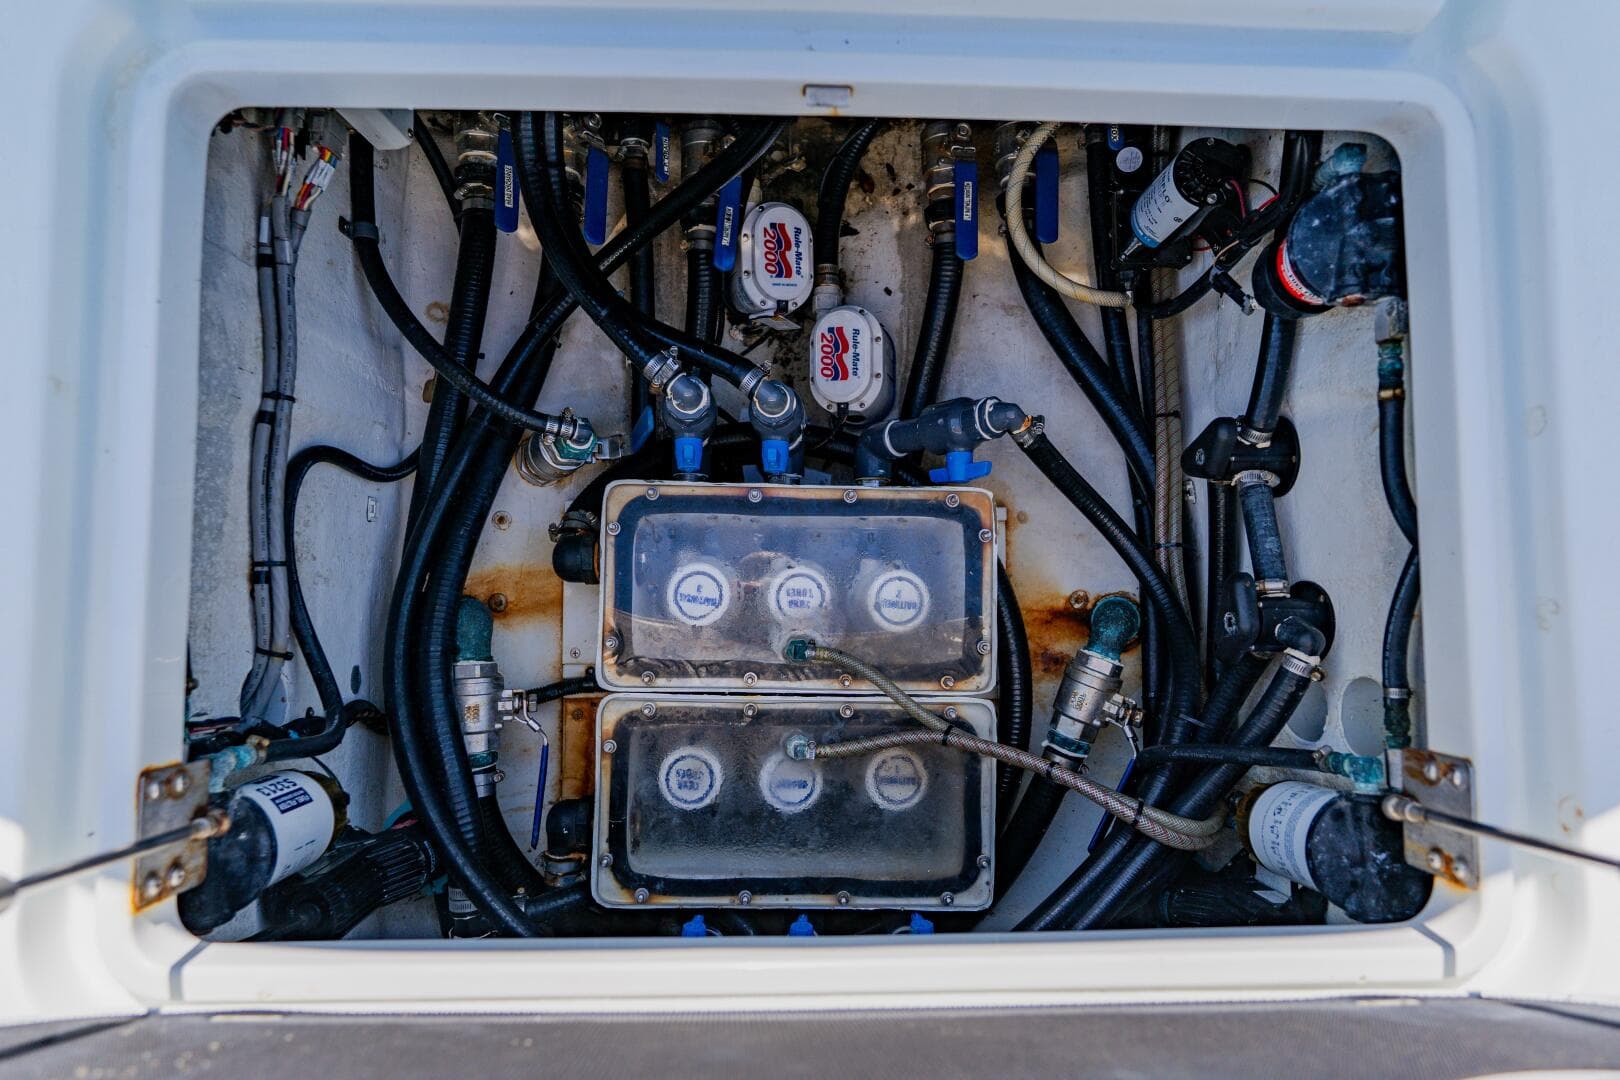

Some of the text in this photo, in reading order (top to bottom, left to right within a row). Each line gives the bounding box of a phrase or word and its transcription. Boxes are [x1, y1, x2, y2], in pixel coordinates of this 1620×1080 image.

[763, 227, 778, 275] 2000
[793, 226, 804, 277] Rule-Mate
[820, 332, 835, 379] 2000
[851, 327, 861, 377] Rule-Mate
[256, 778, 298, 797] S3213
